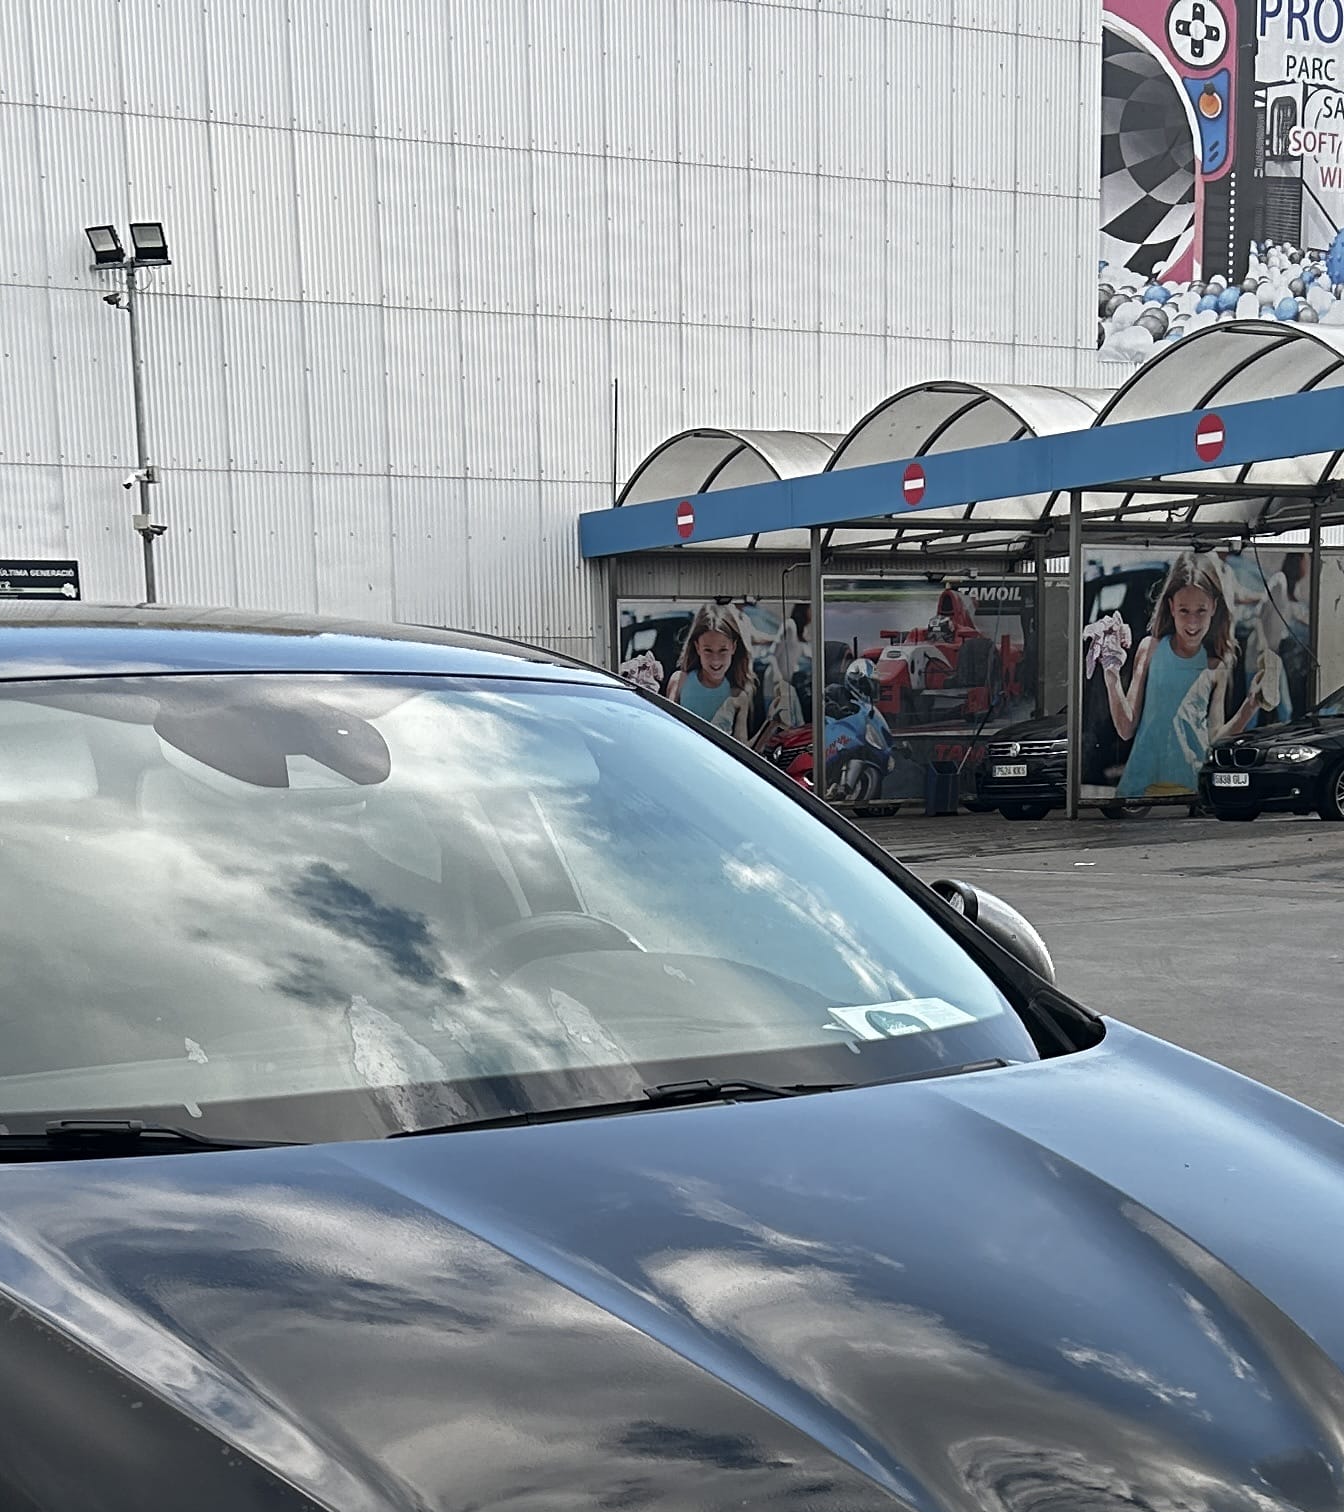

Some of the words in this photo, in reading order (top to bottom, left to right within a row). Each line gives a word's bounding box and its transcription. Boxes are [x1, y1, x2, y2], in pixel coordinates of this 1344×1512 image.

[1286, 55, 1336, 82] PARC
[1291, 130, 1339, 153] SOFT
[957, 586, 1022, 601] TAMOIL
